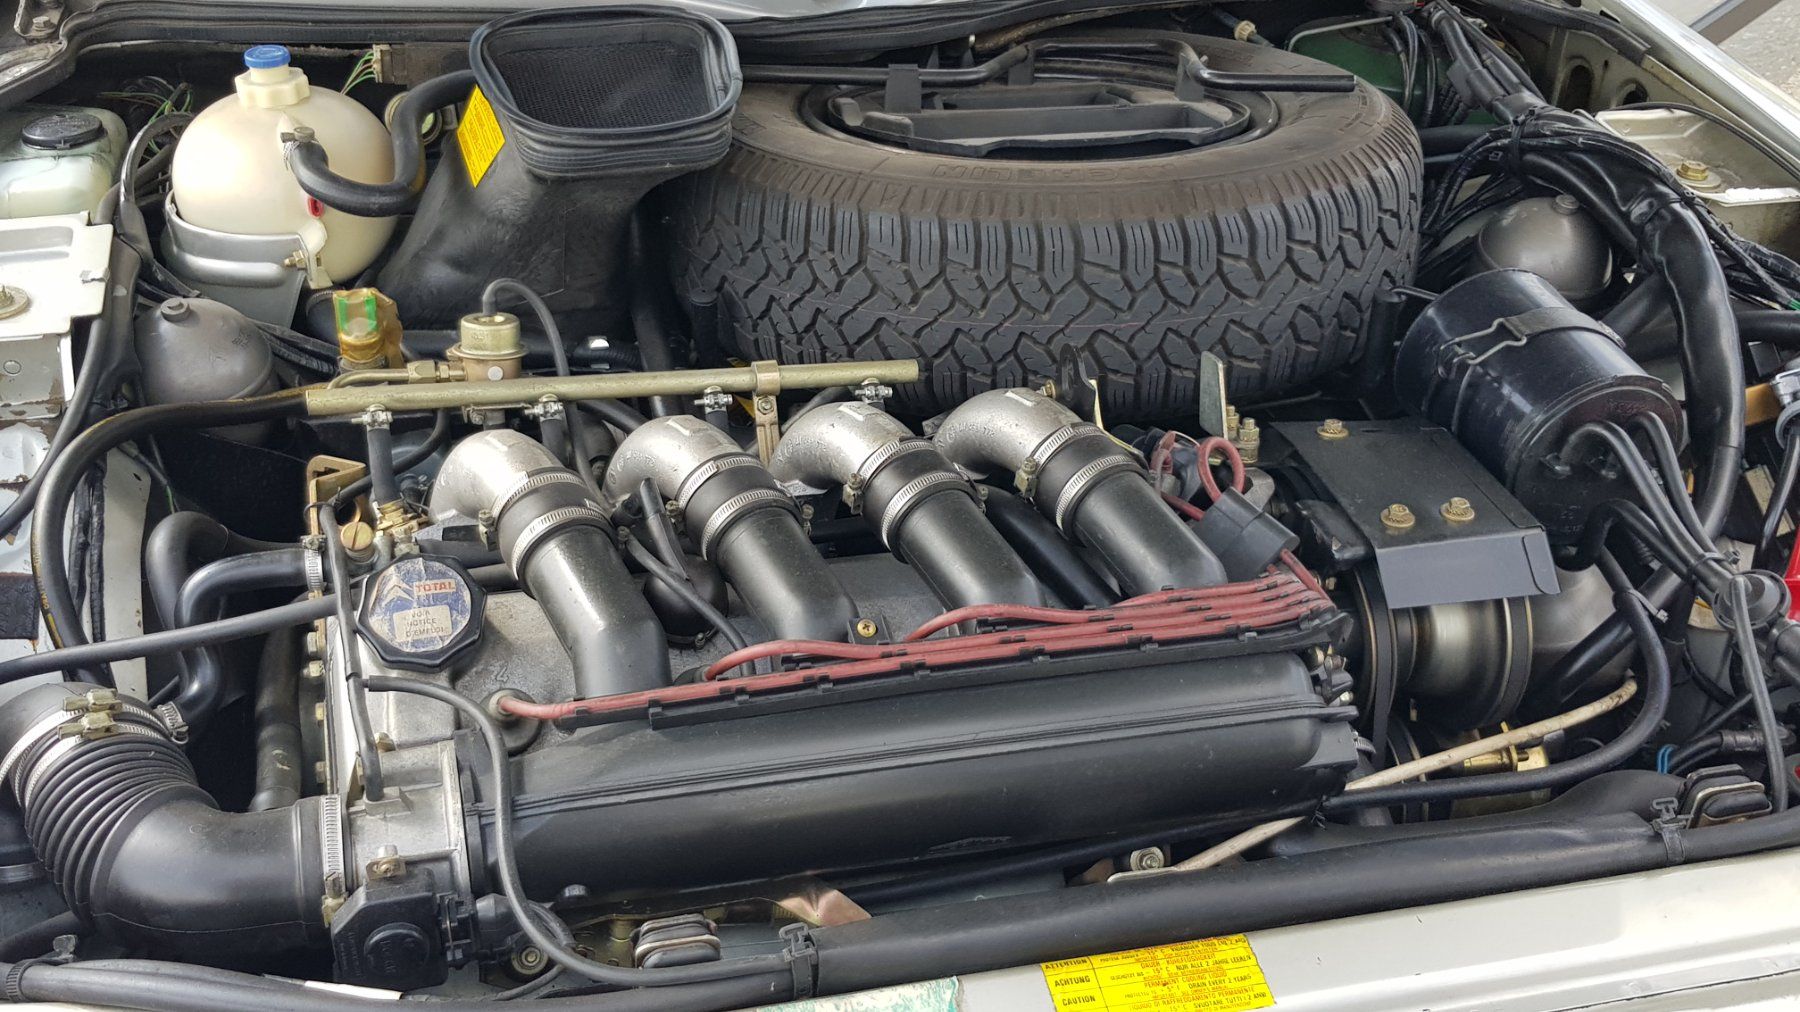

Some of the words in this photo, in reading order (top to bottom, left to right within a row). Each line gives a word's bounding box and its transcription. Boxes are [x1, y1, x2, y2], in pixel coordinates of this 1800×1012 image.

[415, 581, 455, 592] TOTAL
[406, 617, 437, 627] NOTICE
[1045, 958, 1087, 970] ATTENTION
[1054, 975, 1091, 987] ACHTUNG
[1062, 995, 1096, 1006] CAUTION
